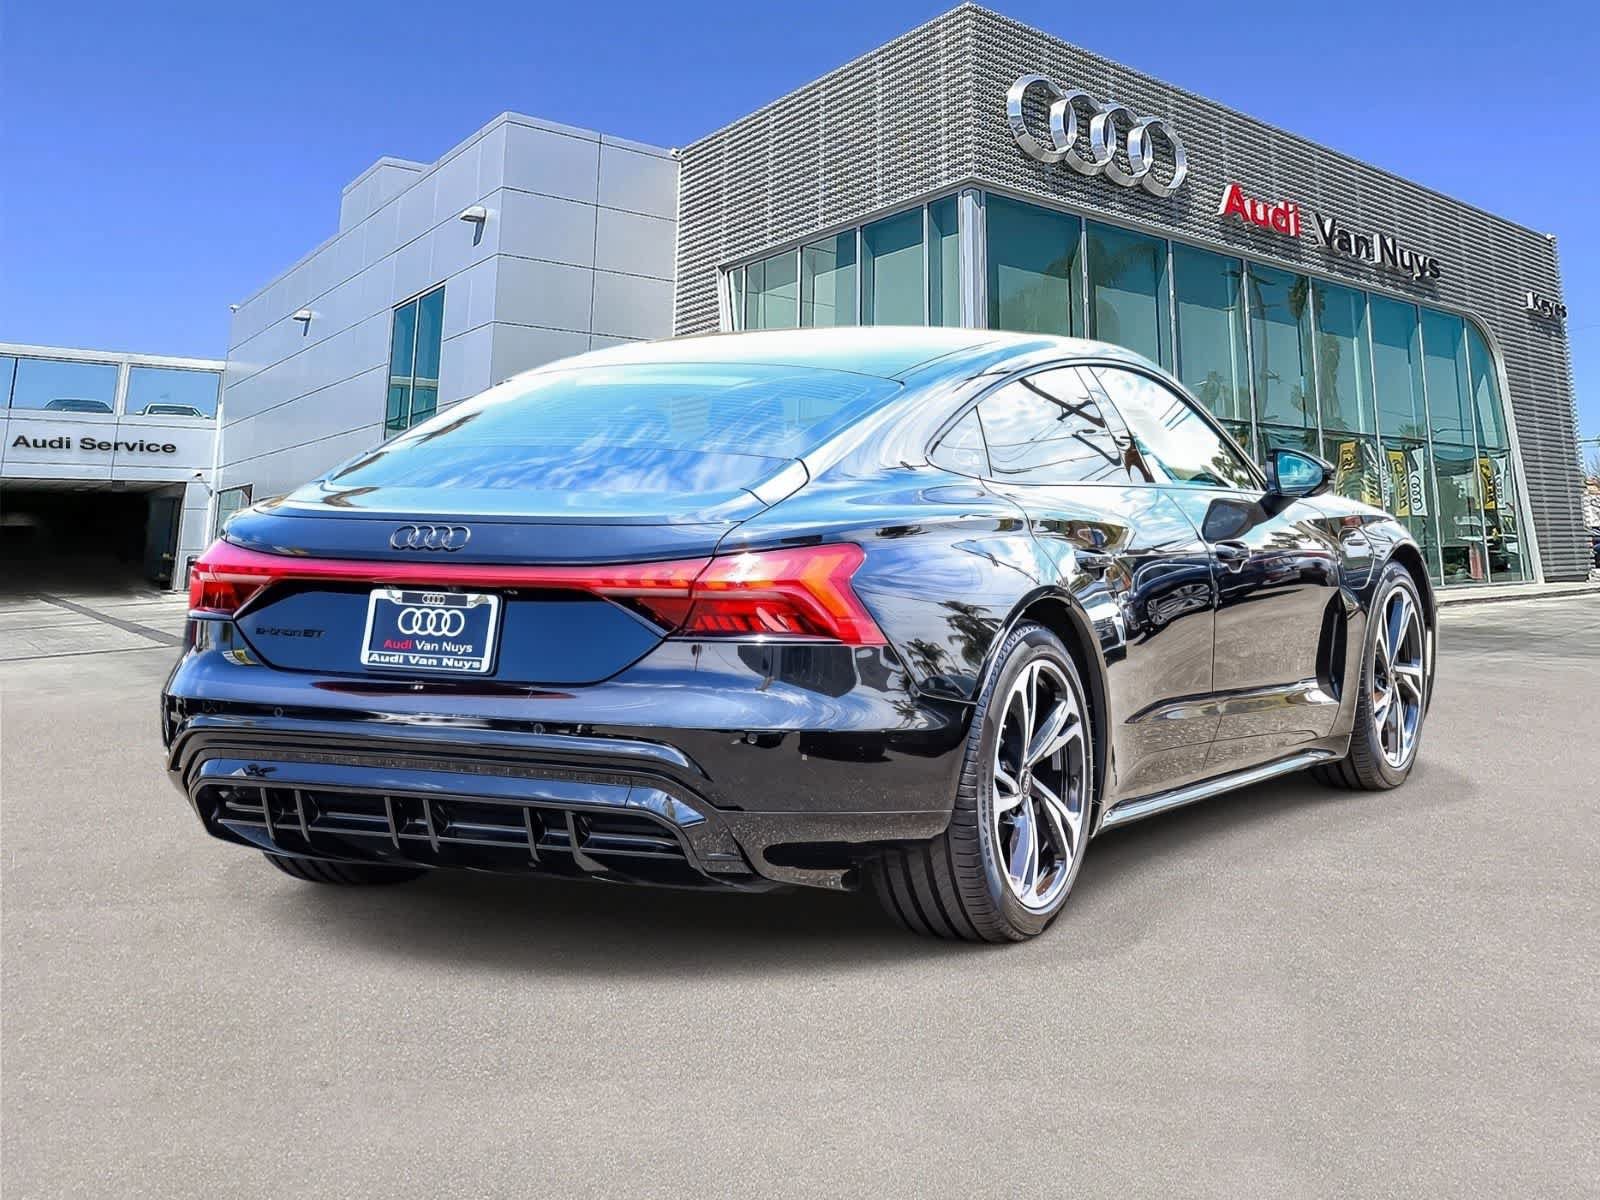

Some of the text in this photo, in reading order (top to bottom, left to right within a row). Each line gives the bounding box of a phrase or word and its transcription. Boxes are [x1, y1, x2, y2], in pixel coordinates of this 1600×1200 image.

[1217, 182, 1441, 280] Audi Van Nuys
[1527, 291, 1568, 319] Keyes
[12, 435, 177, 454] Audi Service
[383, 639, 473, 655] Audi Van Nuys
[369, 653, 482, 670] Audi Van Nuys
